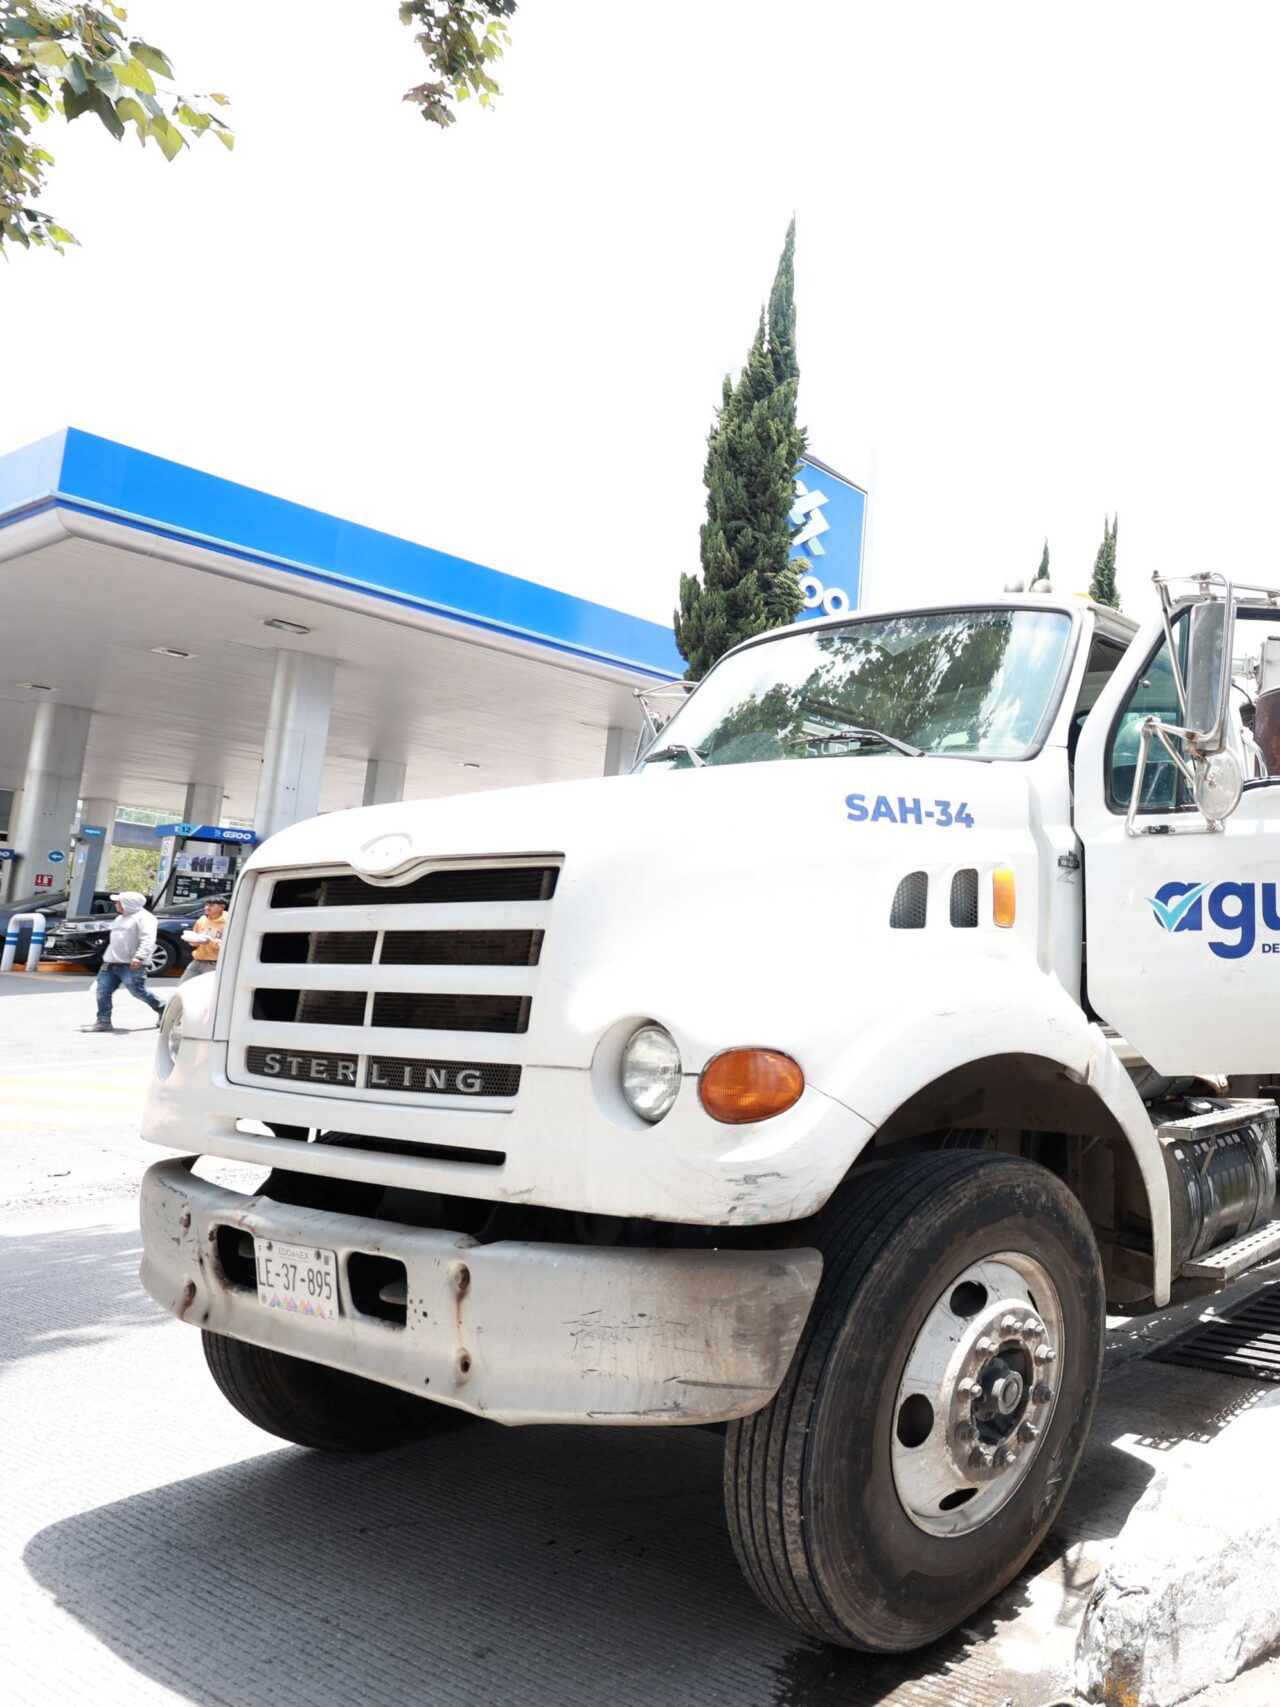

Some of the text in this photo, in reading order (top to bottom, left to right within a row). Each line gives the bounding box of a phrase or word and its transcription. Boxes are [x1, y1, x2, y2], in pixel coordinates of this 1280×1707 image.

[845, 793, 975, 828] SAH-34
[1261, 943, 1280, 954] DE
[263, 1052, 484, 1093] STERLING
[256, 1256, 332, 1301] LE-37-895
